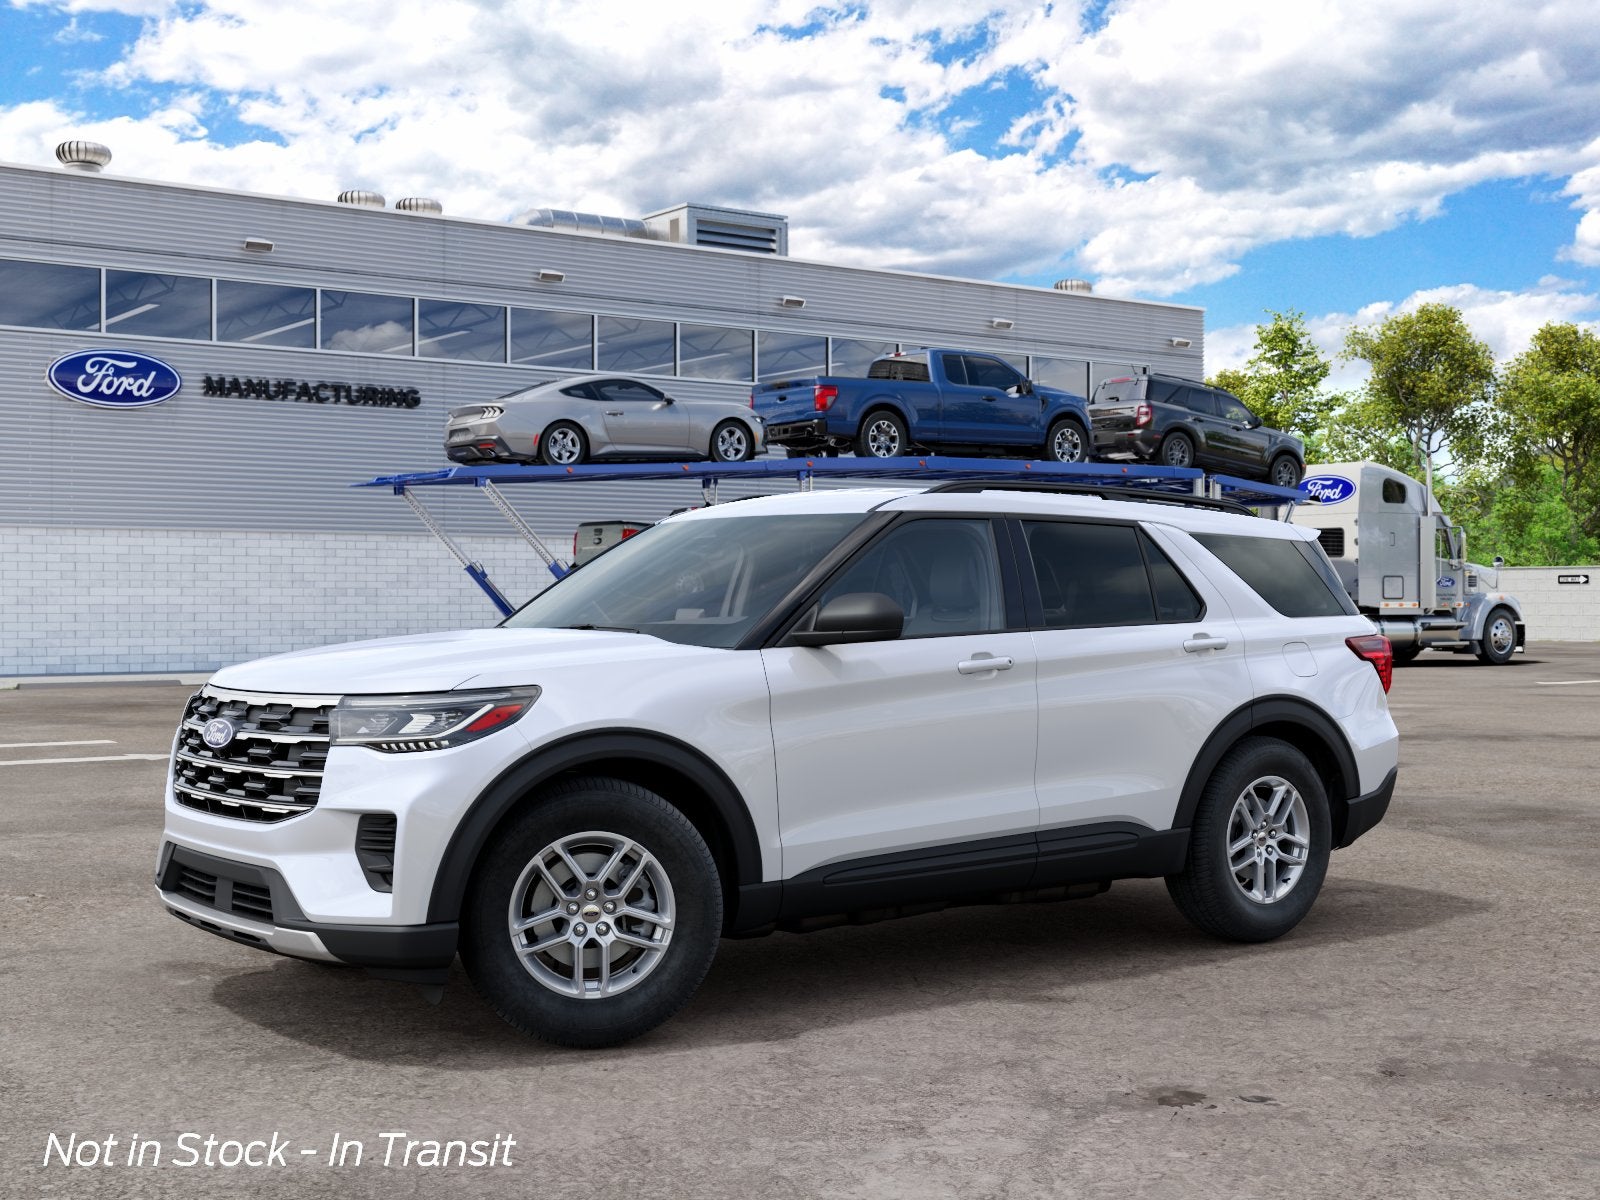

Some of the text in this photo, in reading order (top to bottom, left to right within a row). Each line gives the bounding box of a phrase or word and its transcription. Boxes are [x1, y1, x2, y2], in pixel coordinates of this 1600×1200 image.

[77, 356, 421, 408] Ford MANUFACTURING
[1306, 480, 1343, 500] Ford
[206, 722, 228, 743] Ford
